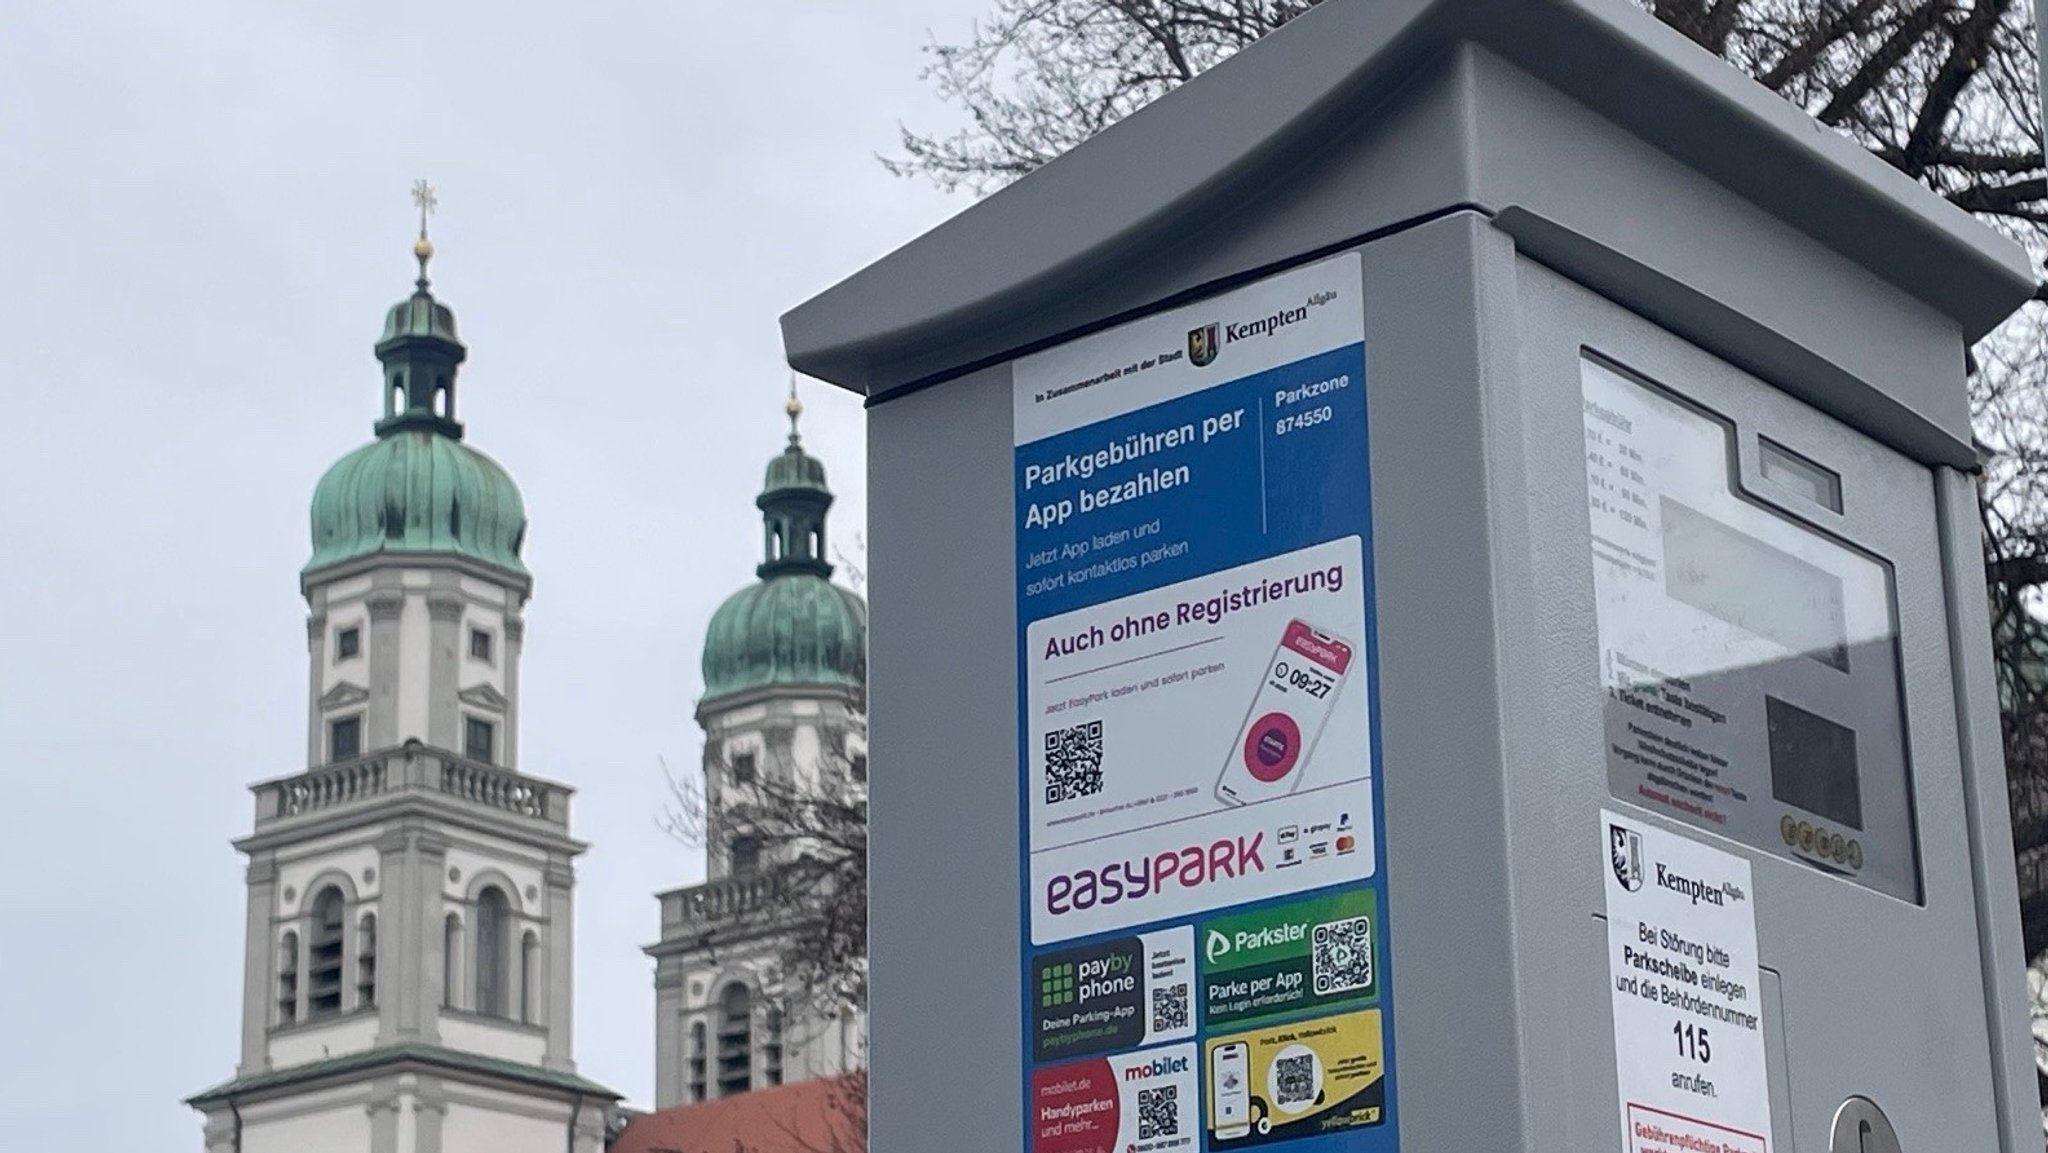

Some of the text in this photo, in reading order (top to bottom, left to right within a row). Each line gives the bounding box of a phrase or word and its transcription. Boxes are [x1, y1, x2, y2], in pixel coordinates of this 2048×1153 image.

[1225, 289, 1337, 344] Kempten Allgäu
[1046, 368, 1122, 401] Zusammenarbeit
[1123, 363, 1138, 377] mit
[1140, 356, 1155, 371] der
[1158, 349, 1183, 366] Stadt
[1275, 374, 1349, 408] Parkzone
[1275, 406, 1332, 435] 874550
[1025, 407, 1244, 490] Parkgebühren per
[1025, 463, 1190, 530] App bezahlen
[1025, 518, 1160, 570] Jetzt App laden und
[1026, 539, 1189, 597] sofort kontaktlos parken
[1044, 565, 1344, 660] Auch ohne Registrierung
[1111, 681, 1138, 698] laden
[1161, 670, 1189, 688] sofort
[1191, 662, 1225, 682] parken
[1290, 669, 1331, 699] 09:27
[1655, 862, 1724, 907] Kempten
[1235, 922, 1308, 952] Parkster
[1638, 922, 1730, 968] Bei Störung bitte
[1079, 974, 1135, 1004] phone
[1209, 970, 1303, 1000] Parke per App
[1624, 945, 1747, 1001] Parkscheibe einlegen
[1042, 1004, 1135, 1031] Deine Parking-App
[1228, 998, 1251, 1015] Login
[1616, 974, 1758, 1032] und die Behördennummer
[1673, 1020, 1711, 1063] 115
[1125, 1056, 1189, 1082] mobilet
[1672, 1070, 1717, 1098] anrufen.
[1040, 1077, 1091, 1097] mobilet.de
[1041, 1097, 1114, 1123] Handyparken
[1041, 1119, 1061, 1138] und
